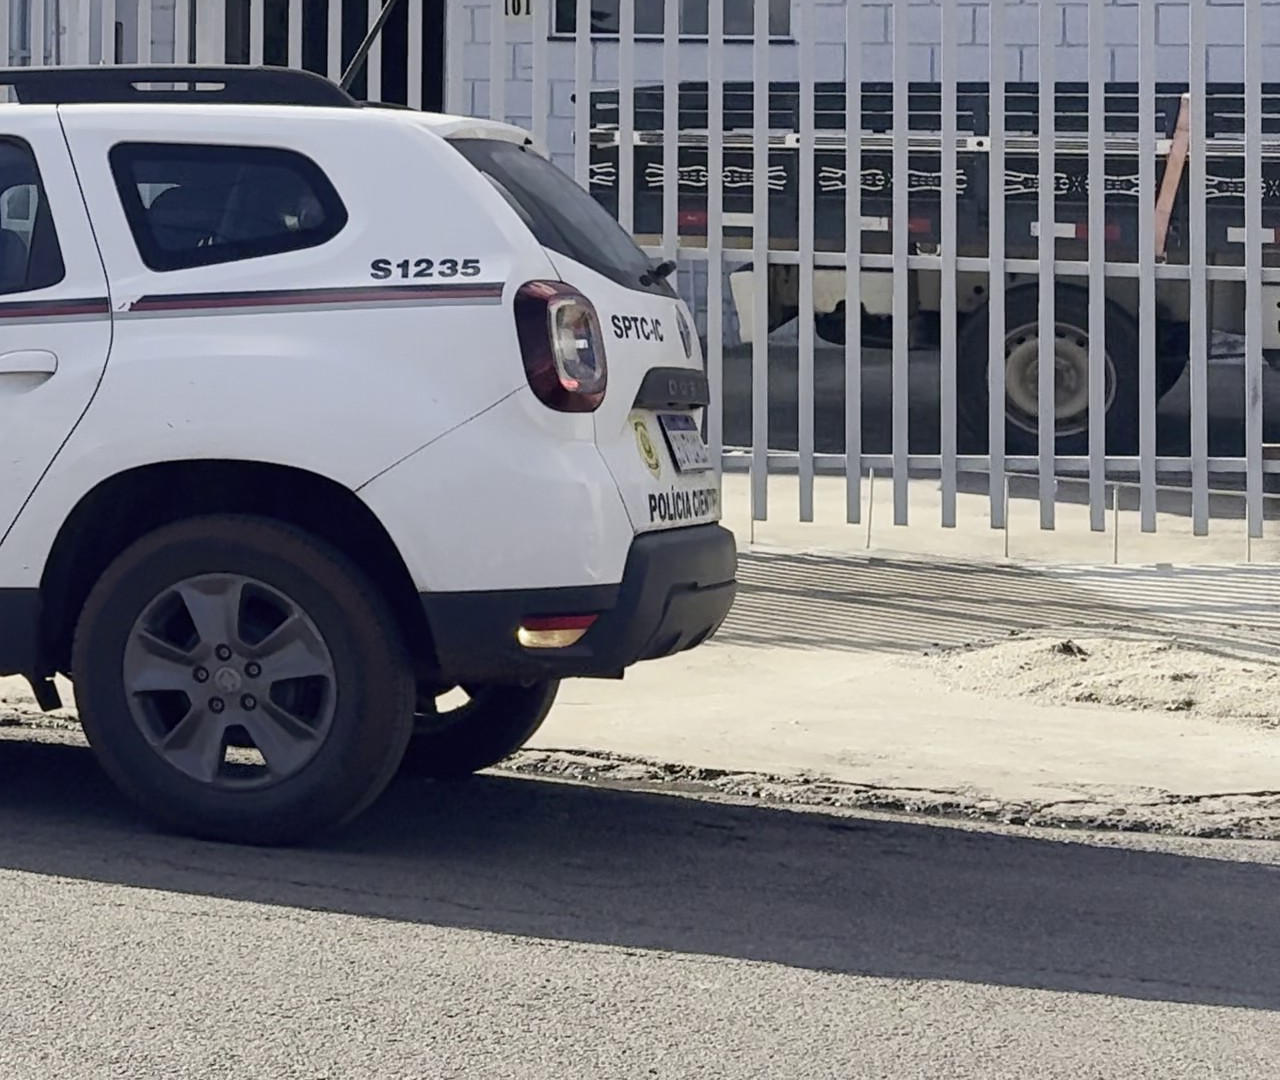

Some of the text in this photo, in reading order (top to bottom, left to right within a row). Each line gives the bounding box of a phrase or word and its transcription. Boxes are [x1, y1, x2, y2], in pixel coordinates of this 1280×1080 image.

[370, 258, 481, 280] S1235
[611, 314, 664, 342] SPTC-IC
[648, 484, 692, 522] POLÍCIA
